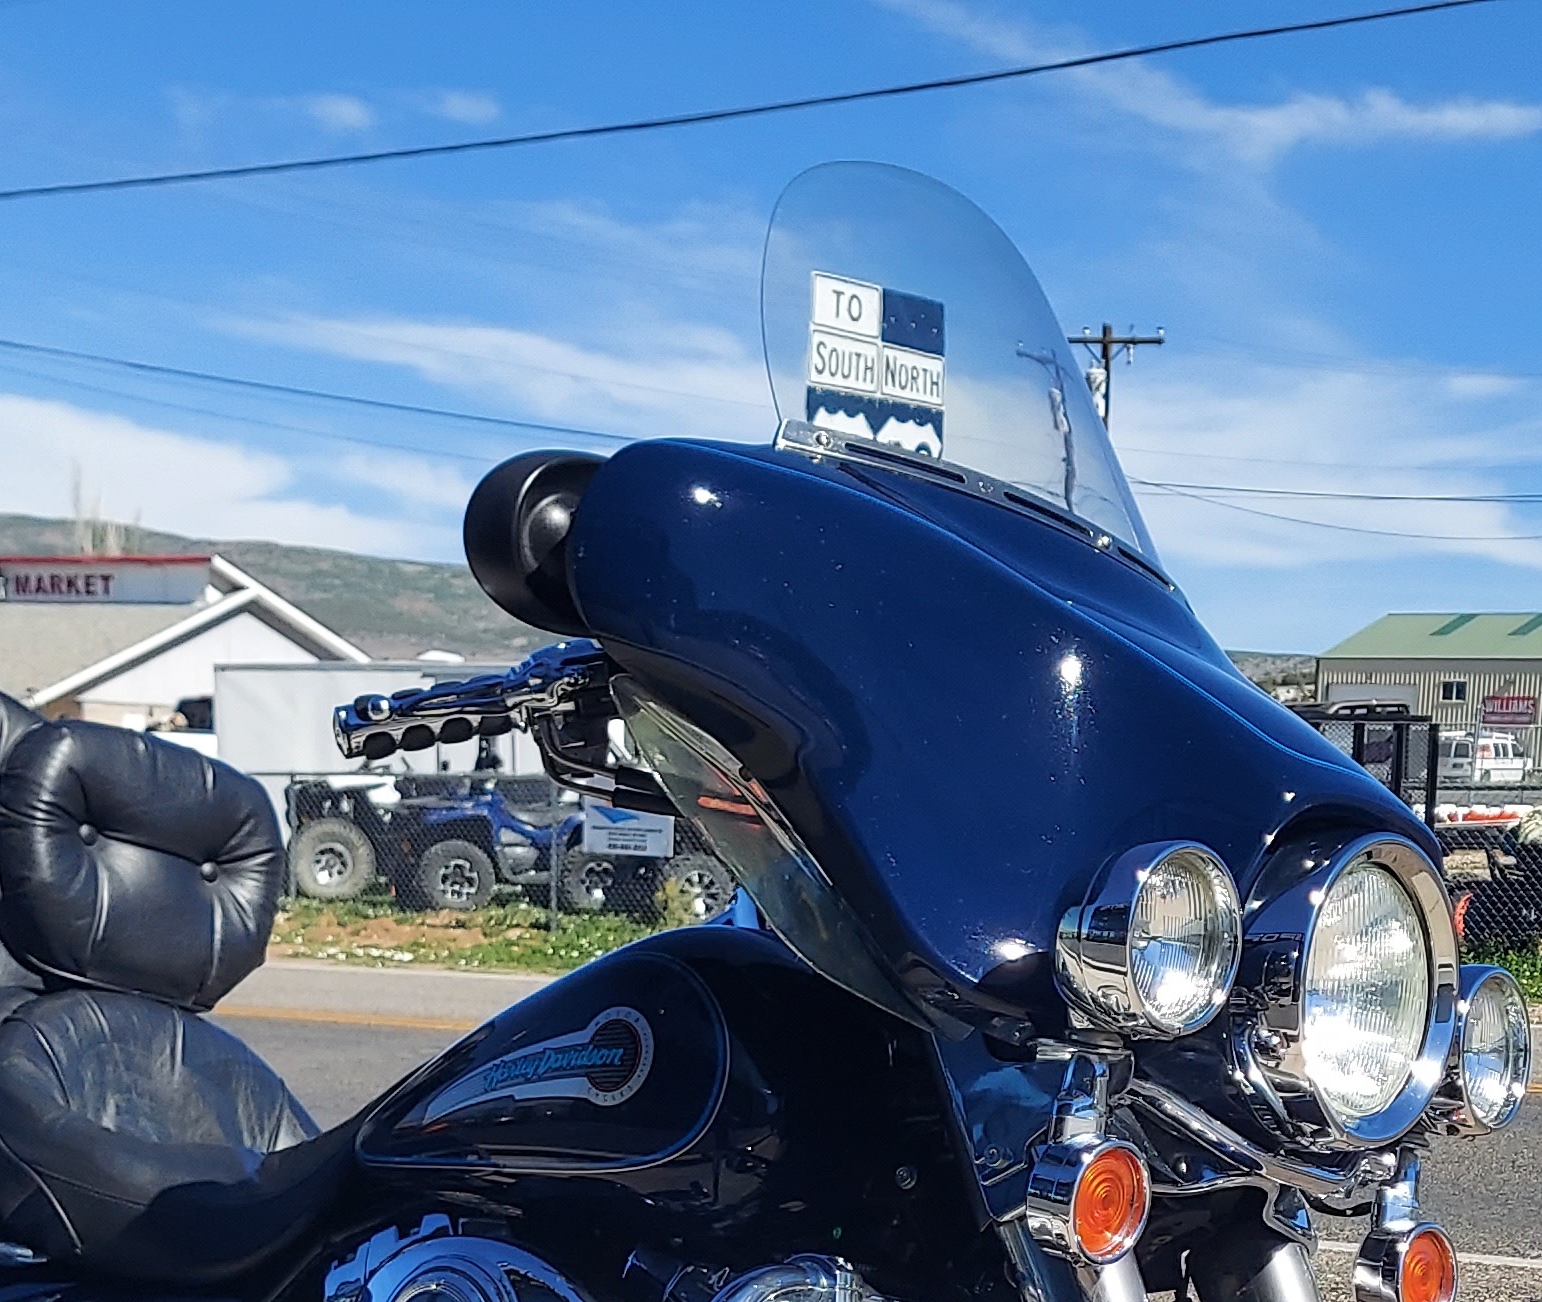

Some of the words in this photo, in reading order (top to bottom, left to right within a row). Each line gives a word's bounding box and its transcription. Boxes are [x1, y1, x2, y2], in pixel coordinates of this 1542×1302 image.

[832, 289, 862, 322] TO
[814, 341, 875, 384] SOUTH
[885, 355, 940, 398] NORTH
[15, 574, 114, 595] MARKET
[1484, 699, 1534, 713] WILLIAMS
